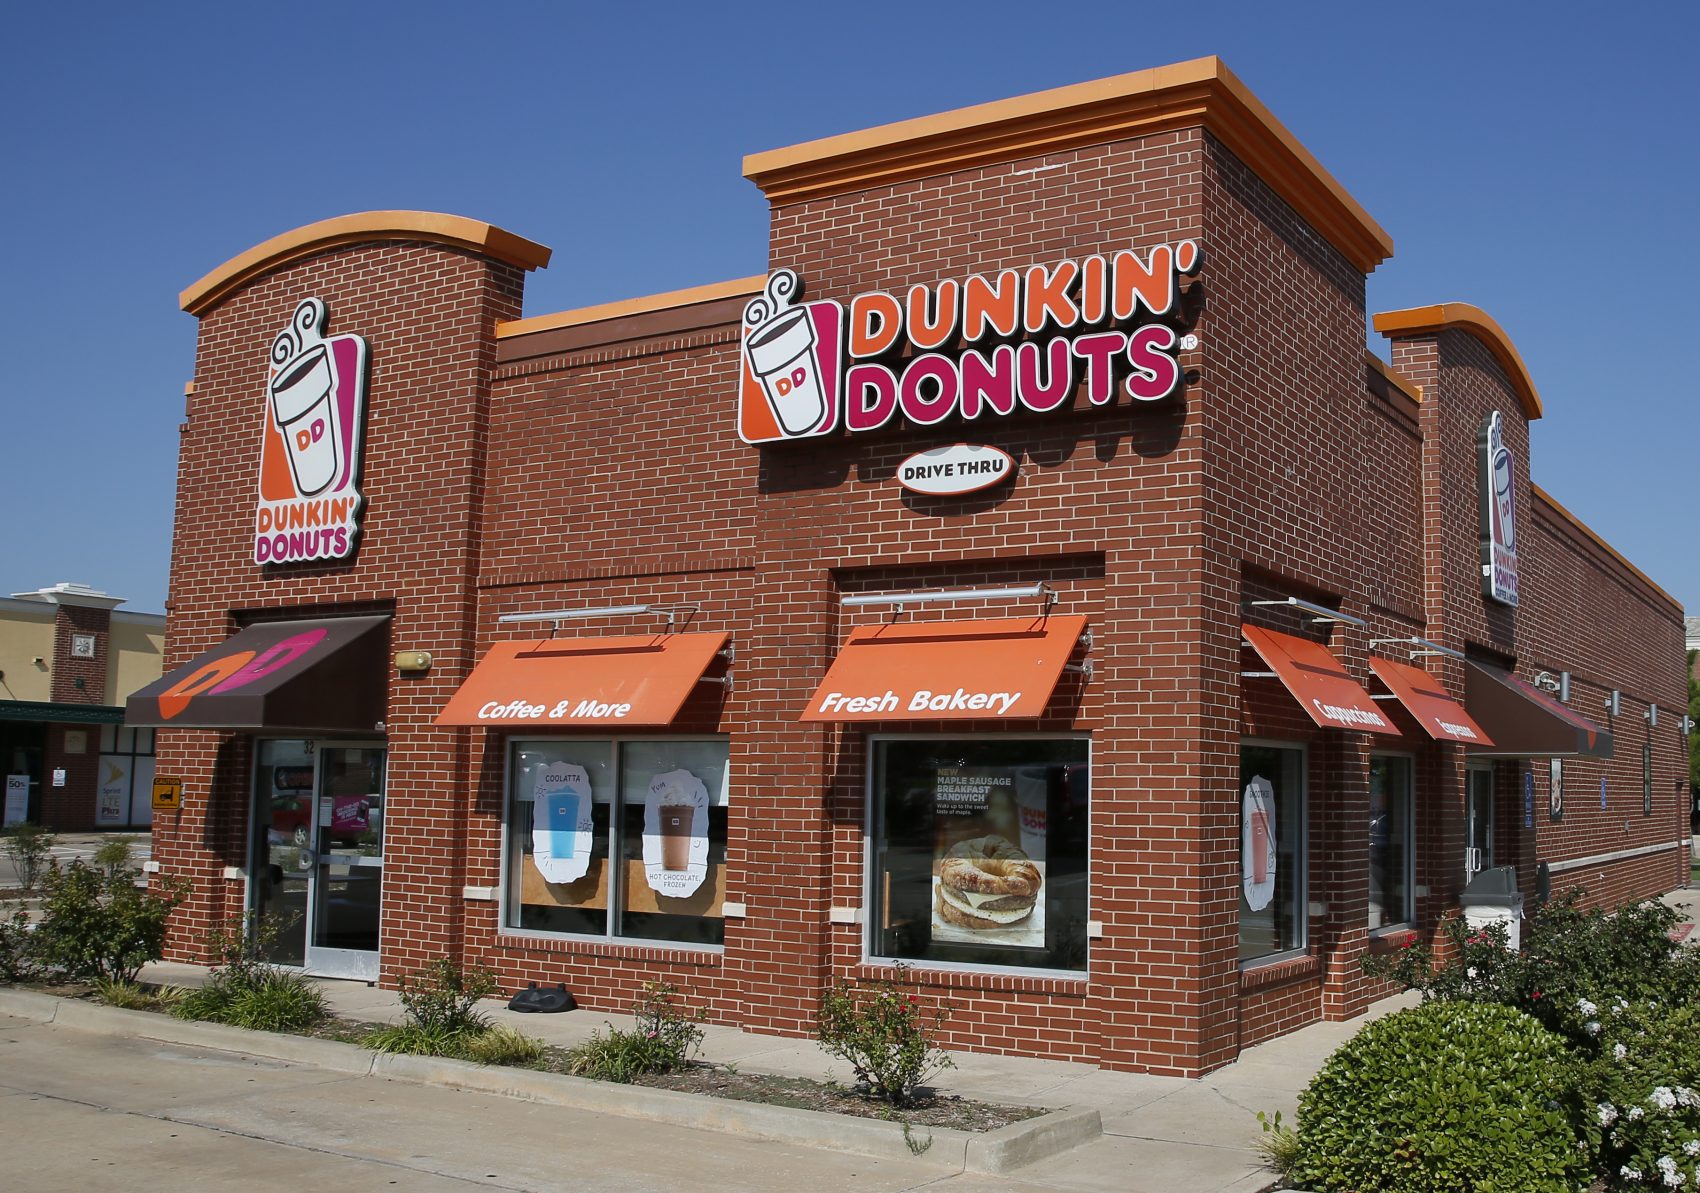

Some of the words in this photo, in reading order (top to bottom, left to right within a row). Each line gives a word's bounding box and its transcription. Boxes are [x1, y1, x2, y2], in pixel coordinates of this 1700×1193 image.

[849, 239, 1198, 358] DUNKIN'
[845, 324, 1178, 431] DONUTS
[904, 462, 954, 480] DRIVE
[958, 458, 1004, 476] THRU
[258, 496, 355, 534] DUNKIN'
[257, 526, 347, 562] DONUTS
[1495, 566, 1518, 593] DONUTS
[477, 700, 545, 719] Coffee
[549, 701, 568, 718] &
[570, 700, 631, 718] More
[818, 690, 899, 713] Fresh
[908, 688, 1021, 714] Bakery
[545, 774, 581, 783] COOLATTA
[937, 768, 959, 776] NEW
[937, 776, 968, 785] MAPLE
[969, 777, 1012, 786] SAUSAGE
[936, 793, 985, 802] SANDWICH
[937, 785, 991, 794] BREAKFAST
[649, 873, 662, 881] HOT
